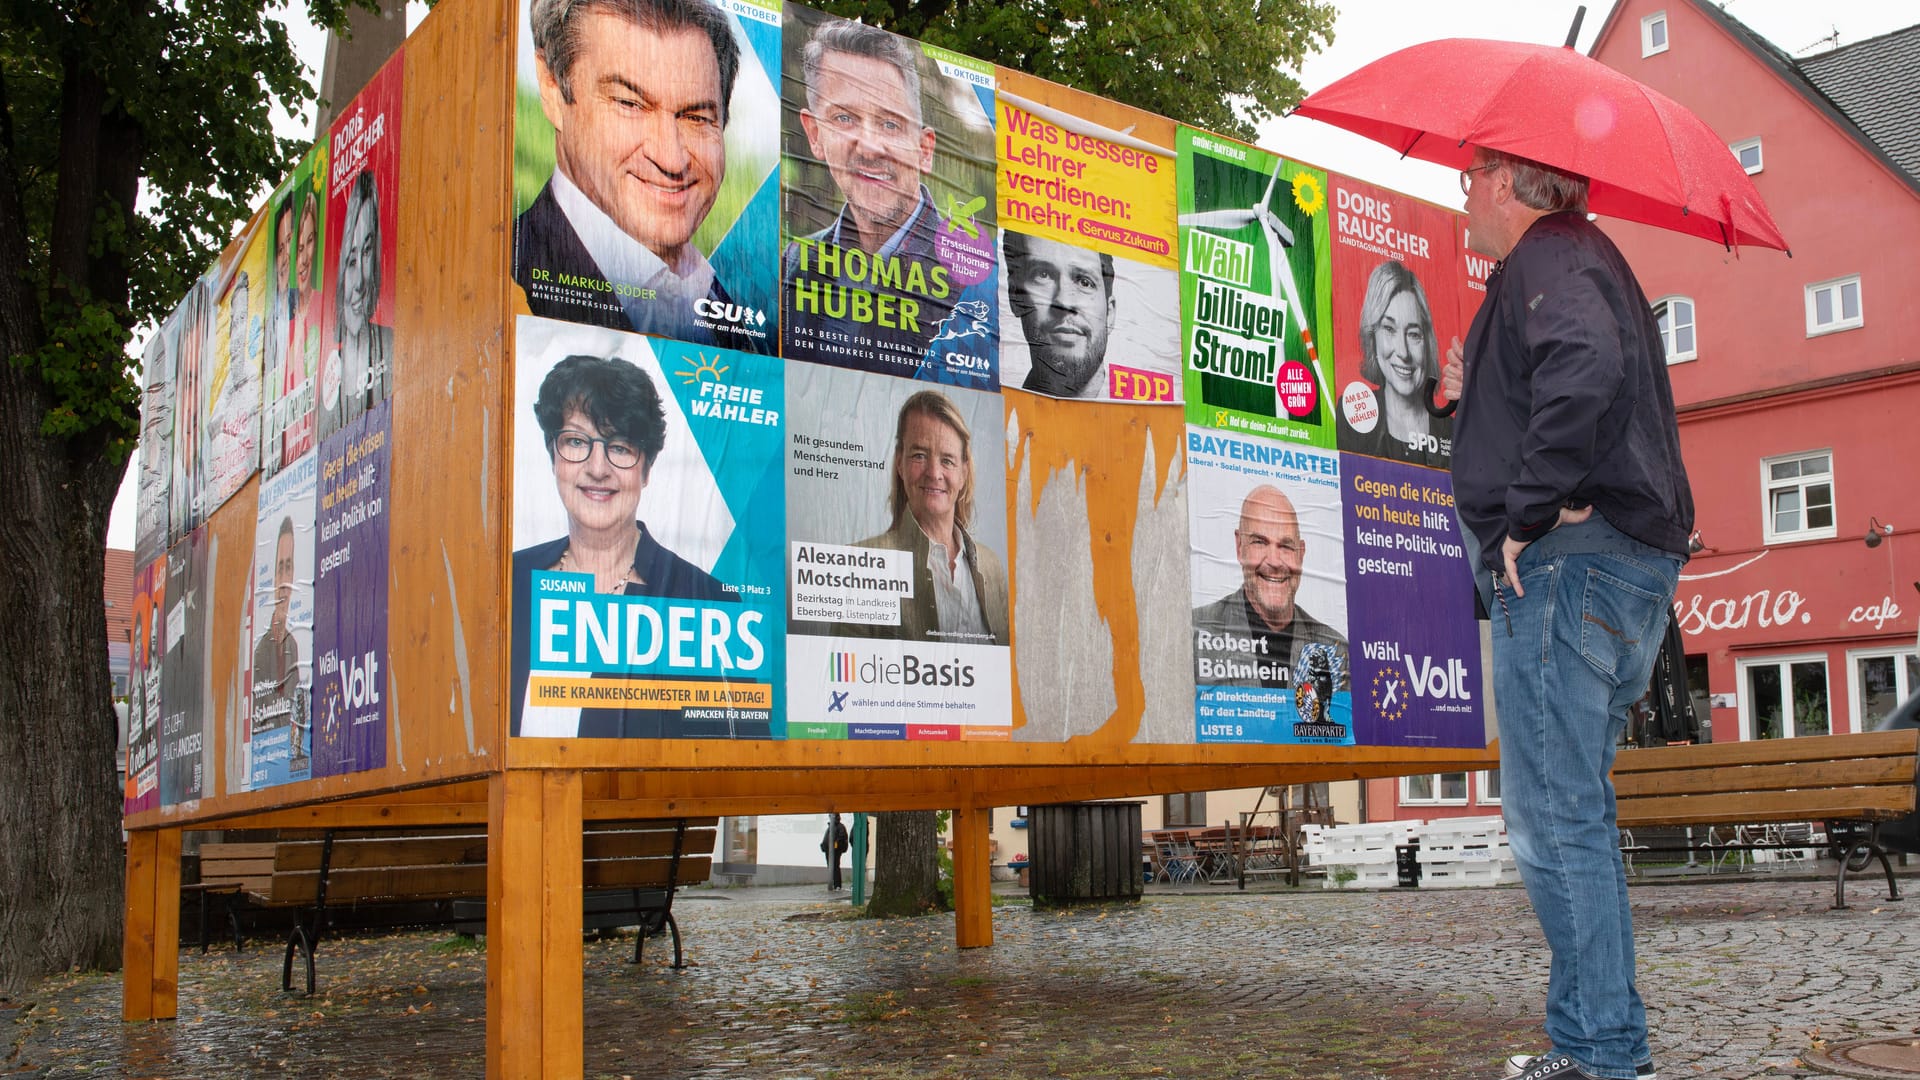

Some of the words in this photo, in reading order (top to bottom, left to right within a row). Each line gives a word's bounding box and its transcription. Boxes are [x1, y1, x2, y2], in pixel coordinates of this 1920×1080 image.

[733, 3, 777, 23] OKTOBER
[927, 48, 990, 73] LANDTAGSWAHL
[944, 66, 952, 75] 8.
[953, 68, 990, 86] OKTOBER
[333, 107, 364, 159] DORIS
[1004, 106, 1059, 145] Was
[1066, 130, 1158, 174] bessere
[332, 112, 385, 186] RAUSCHER
[1006, 135, 1087, 179] Lehrer
[1192, 135, 1247, 161] GRÜNE-BAYERN.DE
[1006, 170, 1131, 220] verdienen:
[1336, 187, 1392, 224] DORIS
[1006, 198, 1075, 233] mehr.
[1082, 221, 1121, 242] Servus
[1123, 231, 1166, 253] Zukunft
[1337, 211, 1430, 259] RAUSCHER
[941, 236, 990, 258] Erststimme
[941, 247, 953, 259] für
[956, 253, 990, 270] Thomas
[1191, 231, 1251, 285] Wähl
[1338, 235, 1390, 257] LANDTAGSWAHL
[1390, 251, 1405, 261] 2023
[793, 236, 950, 299] THOMAS
[952, 262, 979, 278] Huber
[532, 268, 554, 282] DR.
[558, 273, 612, 292] MARKUS
[616, 283, 657, 300] SÖDER
[532, 283, 593, 299] BAYERISCHER
[532, 292, 624, 313] MINISTERPRÄSIDENT
[693, 298, 743, 322] CSU
[795, 277, 921, 334] HUBER
[1197, 281, 1284, 340] billigen
[693, 319, 716, 329] Näher
[730, 325, 766, 338] Menschen
[795, 326, 814, 336] DAS
[819, 329, 850, 342] BESTE
[854, 335, 872, 346] FÜR
[877, 340, 913, 354] BAYERN
[917, 348, 936, 357] UND
[795, 339, 814, 349] DEN
[819, 343, 874, 359] LANDKREIS
[879, 353, 932, 369] EBERSBERG
[945, 352, 976, 368] CSU
[1193, 329, 1276, 384] Strom!
[946, 366, 960, 374] Näher
[968, 369, 991, 379] Menschen
[1287, 368, 1304, 381] ALLE
[699, 381, 763, 405] FREIE
[1113, 370, 1170, 401] FDP
[1280, 382, 1312, 394] STIMMEN
[1345, 394, 1356, 405] AM
[1356, 390, 1371, 401] 8.10.
[691, 399, 779, 427] WÄHLER
[1287, 394, 1306, 408] GRÜN
[1354, 402, 1367, 412] SPD
[1229, 415, 1240, 427] Hol
[1240, 417, 1249, 428] dir
[1249, 419, 1266, 431] deine
[1267, 423, 1289, 436] Zukunft
[1289, 428, 1311, 440] zurück.
[1349, 409, 1377, 425] WÄHLEN!
[359, 430, 385, 459] Krisen
[793, 433, 810, 445] Mit
[812, 438, 864, 452] gesundem
[1188, 432, 1338, 476] BAYERNPARTEI
[1408, 431, 1439, 454] SPD
[793, 449, 885, 470] Menschenverstand
[259, 454, 317, 512] BAYERNPARTEI
[793, 466, 814, 477] und
[816, 468, 839, 480] Herz
[1188, 457, 1214, 468] Liberal
[1220, 462, 1241, 473] Sozial
[1243, 466, 1269, 477] gerecht
[1275, 471, 1301, 483] Kritisch
[1307, 477, 1339, 489] Aufrichtig
[321, 492, 335, 511] von
[335, 478, 358, 504] heute
[1354, 474, 1397, 499] Gegen
[1399, 482, 1419, 502] die
[1422, 487, 1454, 508] Krise
[321, 518, 340, 543] keine
[341, 500, 366, 532] Politik
[367, 497, 382, 519] von
[1355, 504, 1380, 521] von
[1383, 503, 1420, 527] heute
[1422, 510, 1450, 532] hilft
[1356, 526, 1393, 549] keine
[1395, 533, 1438, 555] Politik
[1439, 543, 1462, 558] von
[320, 541, 350, 578] gestern!
[796, 546, 886, 569] Alexandra
[1358, 557, 1413, 577] gestern!
[539, 578, 586, 593] SUSANN
[722, 583, 739, 593] Liste
[740, 584, 746, 593] 3
[747, 584, 765, 594] Platz
[765, 586, 771, 595] 3
[797, 568, 909, 593] Motschmann
[797, 593, 843, 606] Bezirkstag
[845, 595, 855, 605] im
[856, 597, 897, 608] Landkreis
[1848, 596, 1902, 630] cafe
[846, 610, 890, 621] Listenplatz
[891, 612, 897, 621] 7
[539, 598, 765, 671] ENDERS
[1197, 630, 1269, 654] Robert
[319, 648, 338, 676] Wähl
[1362, 640, 1400, 662] Wähl
[339, 650, 380, 711] Volt
[860, 653, 975, 688] dieBasis
[1198, 657, 1289, 681] Böhnlein
[1404, 654, 1471, 701] Volt
[539, 685, 566, 699] IHRE
[570, 685, 691, 702] KRANKENSCHWESTER
[695, 689, 710, 702] IM
[713, 689, 765, 703] LANDTAG!
[851, 698, 879, 708] wählen
[880, 699, 895, 707] und
[917, 700, 944, 709] Stimme
[945, 701, 976, 710] behalten
[1200, 691, 1214, 701] Ihr
[1216, 691, 1287, 704] Direktkandidat
[254, 697, 291, 723] Schmidtke
[684, 709, 724, 719] ANPACKEN
[740, 711, 769, 720] BAYERN
[1200, 707, 1214, 716] für
[1216, 708, 1235, 717] den
[1237, 708, 1276, 720] Landtag
[1446, 705, 1461, 713] mach
[1461, 705, 1472, 713] mit!
[163, 716, 171, 736] ES
[854, 728, 900, 736] Machtbegrenzung
[1201, 724, 1233, 736] LISTE
[1235, 726, 1243, 736] 8
[1294, 724, 1346, 737] BAYERNPARTEI
[147, 733, 158, 762] nie.
[163, 741, 177, 761] AUCH
[177, 731, 202, 759] ANDERS!
